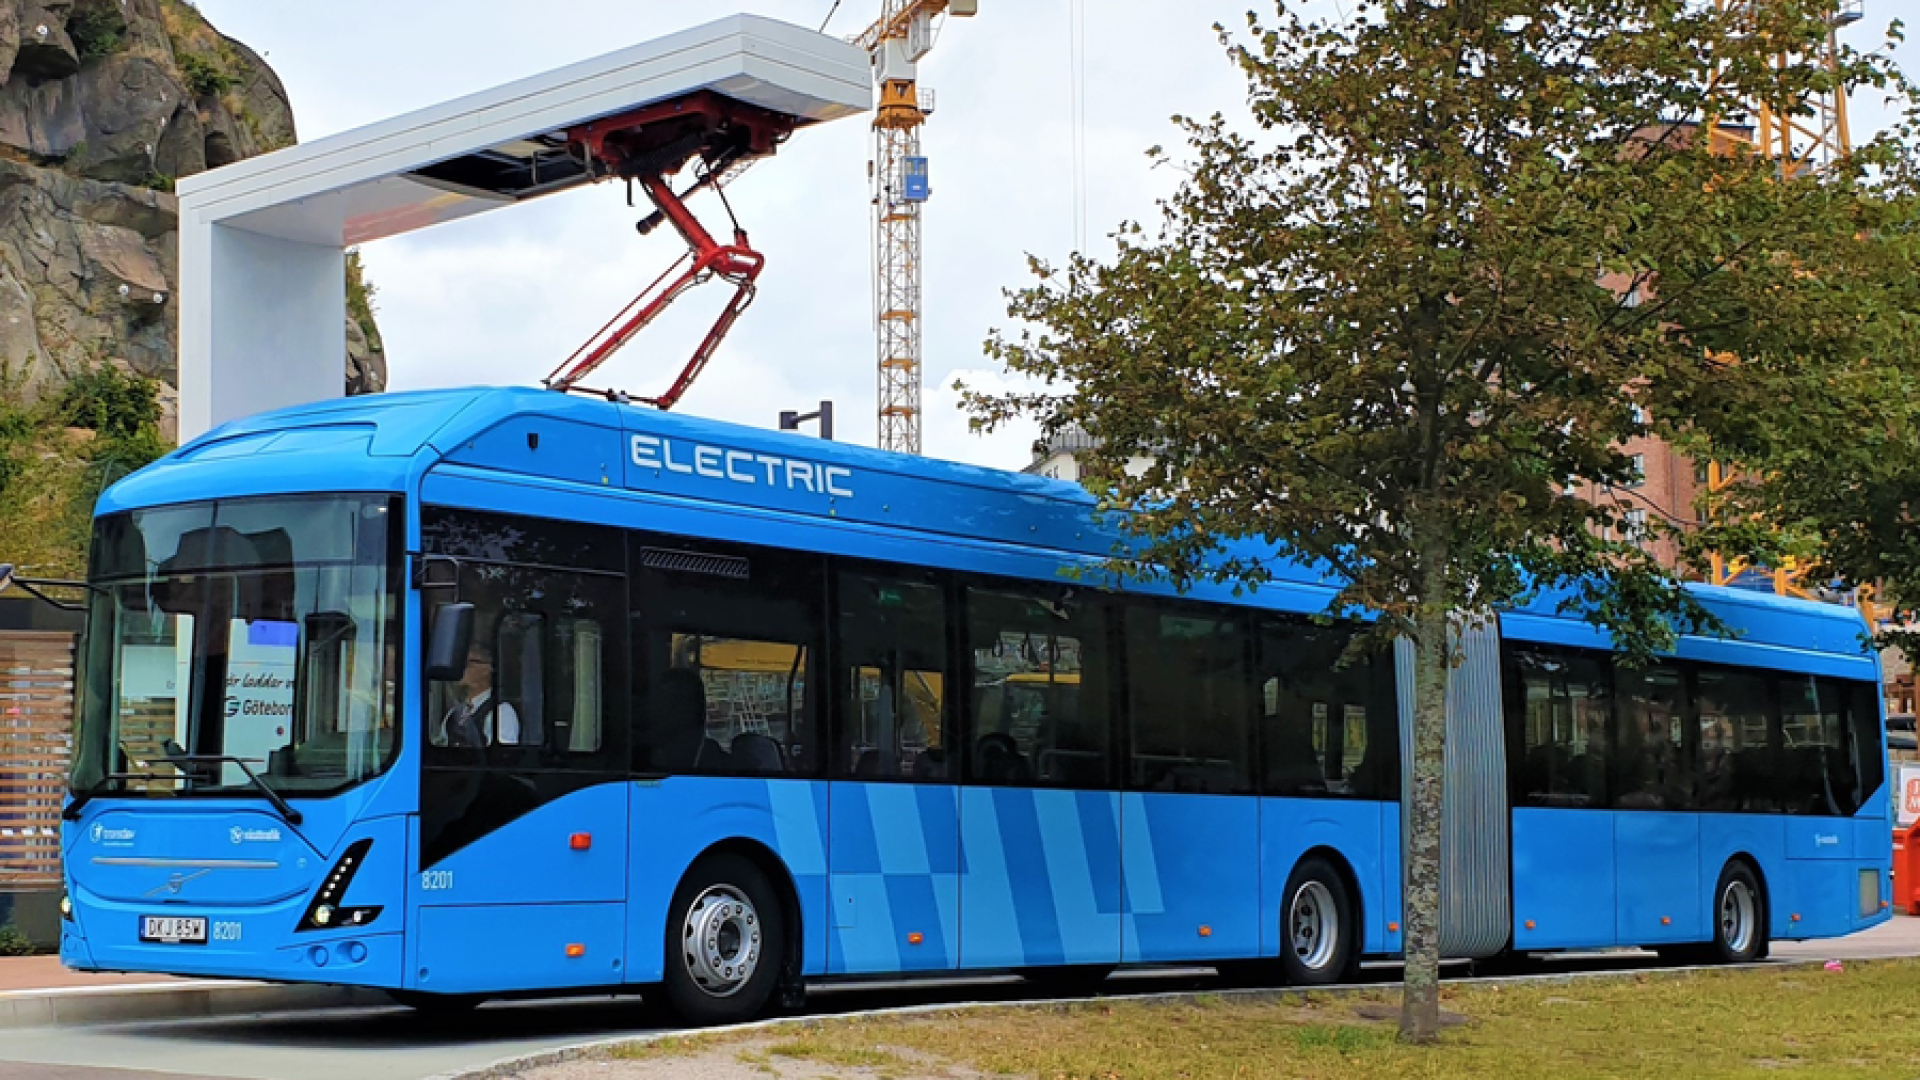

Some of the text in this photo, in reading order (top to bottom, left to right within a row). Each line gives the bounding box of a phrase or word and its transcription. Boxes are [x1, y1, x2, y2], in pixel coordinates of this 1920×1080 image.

[630, 434, 854, 498] ELECTRIC
[243, 699, 293, 715] Götebor
[421, 869, 454, 890] 8201
[213, 921, 242, 940] 8201
